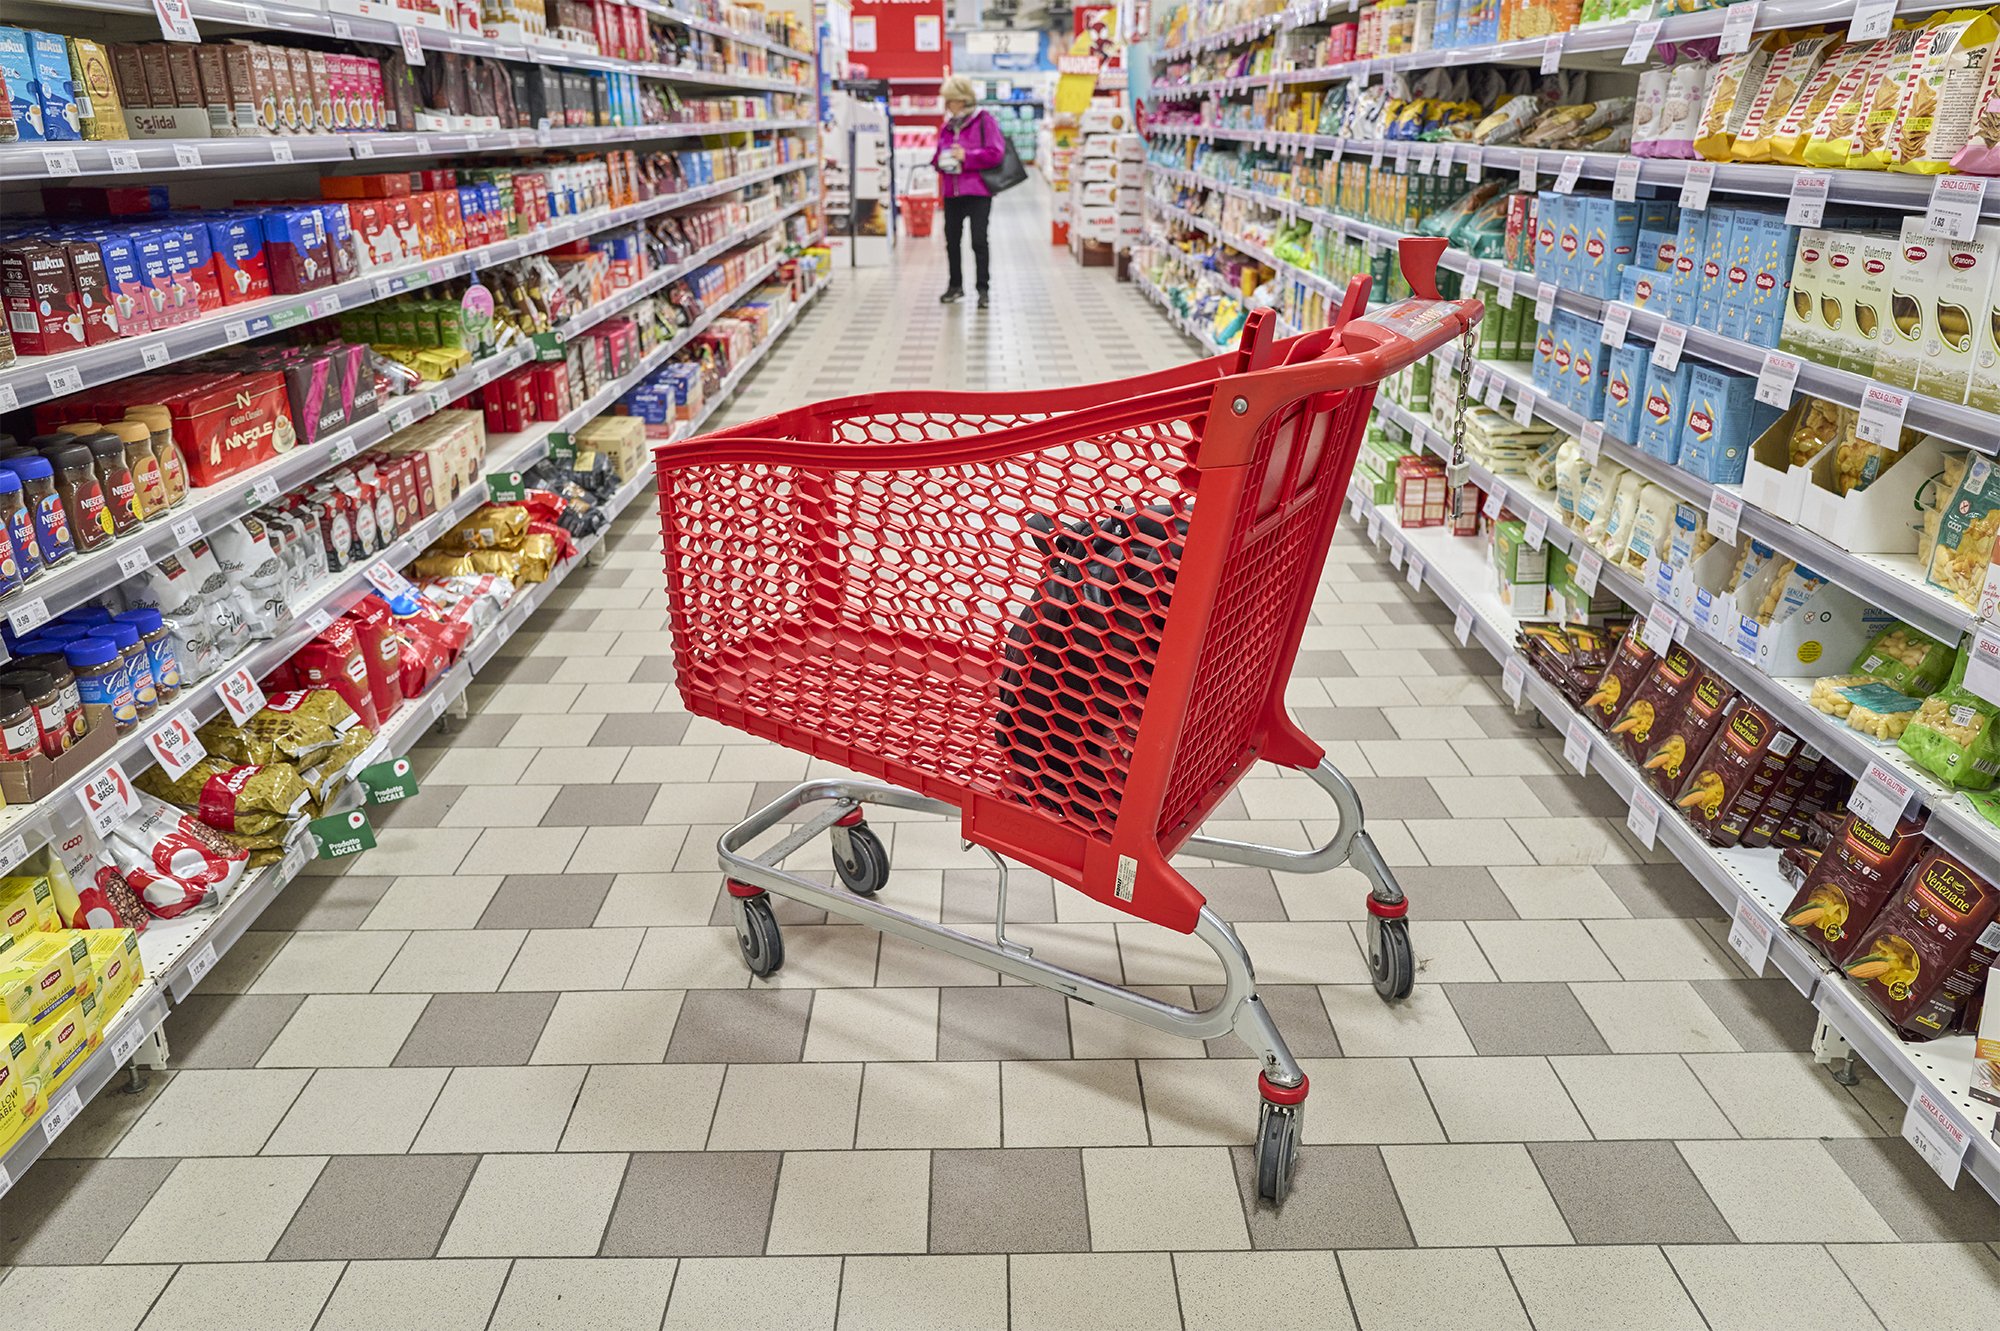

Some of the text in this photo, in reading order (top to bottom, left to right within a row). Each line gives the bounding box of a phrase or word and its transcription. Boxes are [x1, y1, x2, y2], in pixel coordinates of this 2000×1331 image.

[0, 39, 25, 53] AVAZZA
[1741, 44, 1795, 137] FIORENTIN
[134, 115, 177, 130] Solidal
[1940, 180, 1981, 192] SENZA GLUTINE
[1905, 231, 1935, 247] Gluten Free
[1660, 247, 1676, 259] Barill
[1864, 245, 1892, 260] Gluten Free
[1907, 249, 1926, 258] granoro
[1970, 240, 1984, 253] Free
[32, 256, 65, 271] LAVAZZA
[75, 251, 100, 264] LAVAZZA
[146, 260, 163, 269] crema
[167, 256, 183, 265] crema
[1831, 257, 1848, 266] granoro
[1954, 256, 1974, 265] granoro
[113, 265, 132, 273] crema
[1866, 262, 1884, 271] granoro
[79, 276, 93, 286] DEK
[1730, 271, 1746, 281] Barilla
[1757, 277, 1774, 287] Barilla
[36, 283, 54, 294] DEK
[236, 391, 250, 409] N
[1869, 389, 1903, 406] SENZA GLUTINE
[1649, 399, 1668, 415] Barilla
[230, 408, 263, 426] Gusto Classico
[1690, 415, 1711, 432] Barilla
[138, 470, 160, 483] NESCAF
[112, 482, 135, 496] NESCAF
[81, 494, 105, 510] NESCAF
[42, 509, 67, 525] NESCAF
[15, 523, 35, 540] NESCA
[1948, 521, 1962, 532] coop
[1787, 587, 1804, 597] SENZA
[1863, 608, 1882, 616] SENZA
[1980, 640, 1999, 656] SENZA
[1674, 651, 1682, 662] Le
[162, 659, 176, 671] CRASTA
[136, 674, 153, 688] CRASTA
[1706, 681, 1714, 692] Le
[232, 684, 246, 697] BASSI
[114, 691, 132, 706] CRASTA
[1742, 714, 1751, 727] Le
[18, 719, 37, 737] Caff
[166, 727, 175, 738] PIÙ
[1732, 717, 1759, 746] Veneziane
[165, 735, 181, 750] BASSI
[99, 775, 109, 788] PIÙ
[1871, 767, 1908, 797] SENZA GLUTINE
[97, 783, 116, 801] BASSI
[374, 785, 404, 798] Prodotto
[377, 790, 405, 803] LOCALE
[62, 835, 83, 851] coop
[1852, 819, 1891, 854] Veneziane
[328, 838, 361, 851] Prodotto
[331, 844, 363, 857] LOCALE
[1940, 868, 1954, 885] Le
[1925, 869, 1970, 912] Veneziane
[8, 910, 26, 926] Lipton
[108, 962, 121, 979] Lipton
[42, 972, 61, 989] Lipton
[37, 984, 72, 1013] YELLOW LABEL
[44, 993, 69, 1016] DETEINATO
[58, 1024, 75, 1042] Lipton
[10, 1036, 24, 1050] 100%
[56, 1037, 85, 1066] YELLOW LABEL
[0, 1100, 17, 1120] ABEL
[1920, 1094, 1963, 1143] SENZA GLUTINE
[1914, 1135, 1927, 1152] 3,14
